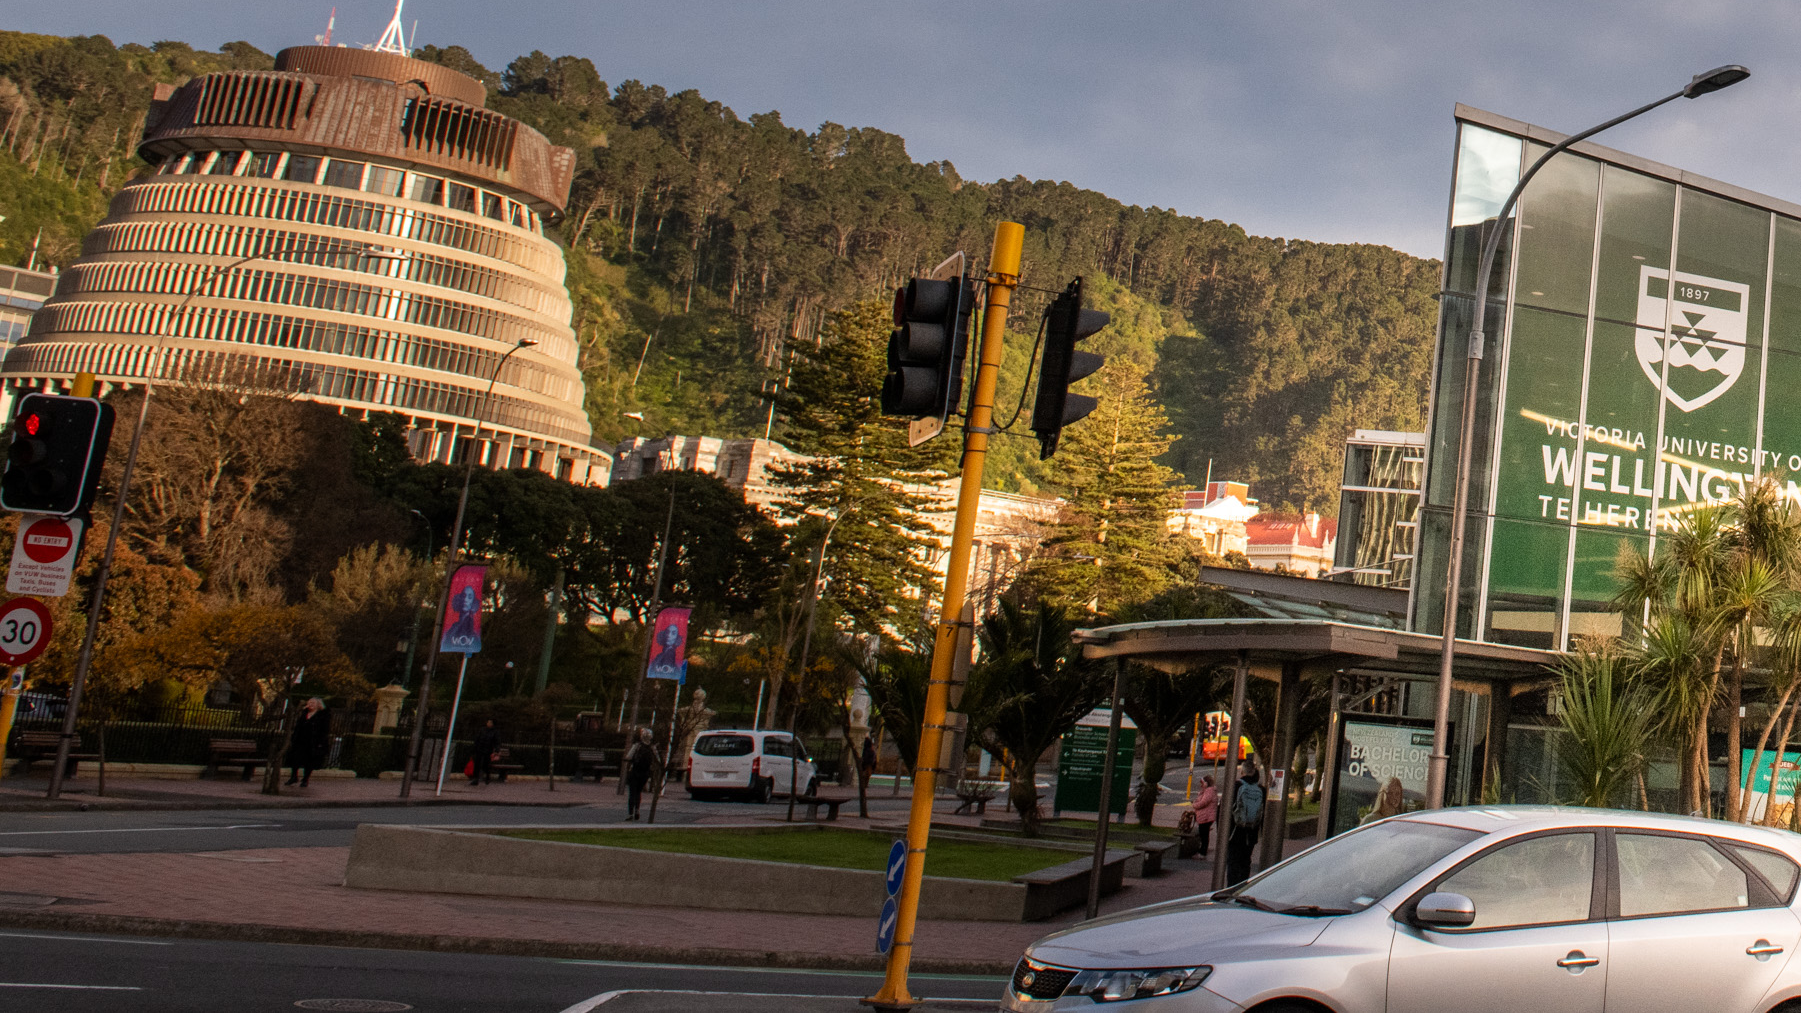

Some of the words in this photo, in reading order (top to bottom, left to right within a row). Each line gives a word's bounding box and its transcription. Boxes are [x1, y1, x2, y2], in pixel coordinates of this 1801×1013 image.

[1680, 287, 1710, 301] 1897
[1544, 418, 1646, 449] VICTORIA
[1659, 435, 1784, 469] UNIVERSITY
[1538, 494, 1570, 521] TE
[40, 572, 66, 580] business
[2, 619, 36, 645] 30
[946, 626, 954, 638] 7
[1351, 744, 1429, 764] BACHELOR
[1349, 762, 1369, 777] OF
